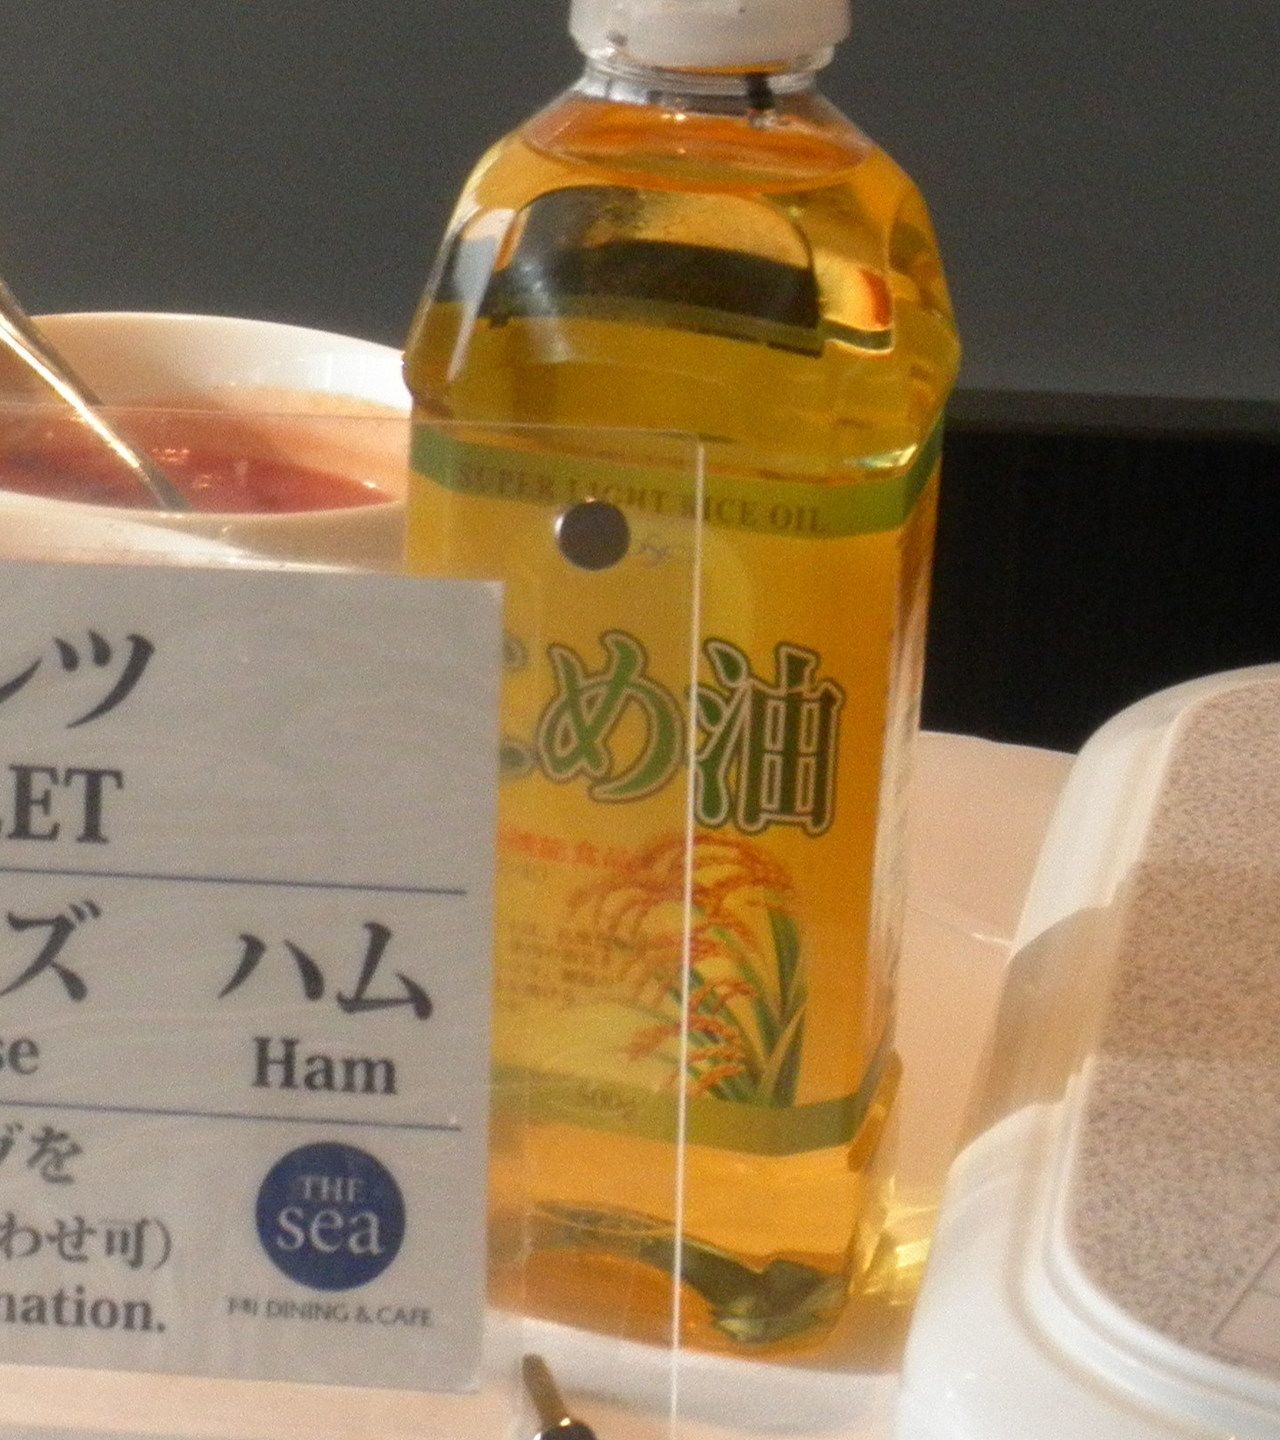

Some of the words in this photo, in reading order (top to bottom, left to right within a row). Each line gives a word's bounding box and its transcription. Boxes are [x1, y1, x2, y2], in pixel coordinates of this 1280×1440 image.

[768, 503, 828, 533] OIL
[218, 921, 434, 1021] ハム
[250, 1036, 398, 1095] Ham
[300, 1174, 364, 1203] THE
[275, 1207, 384, 1257] sea
